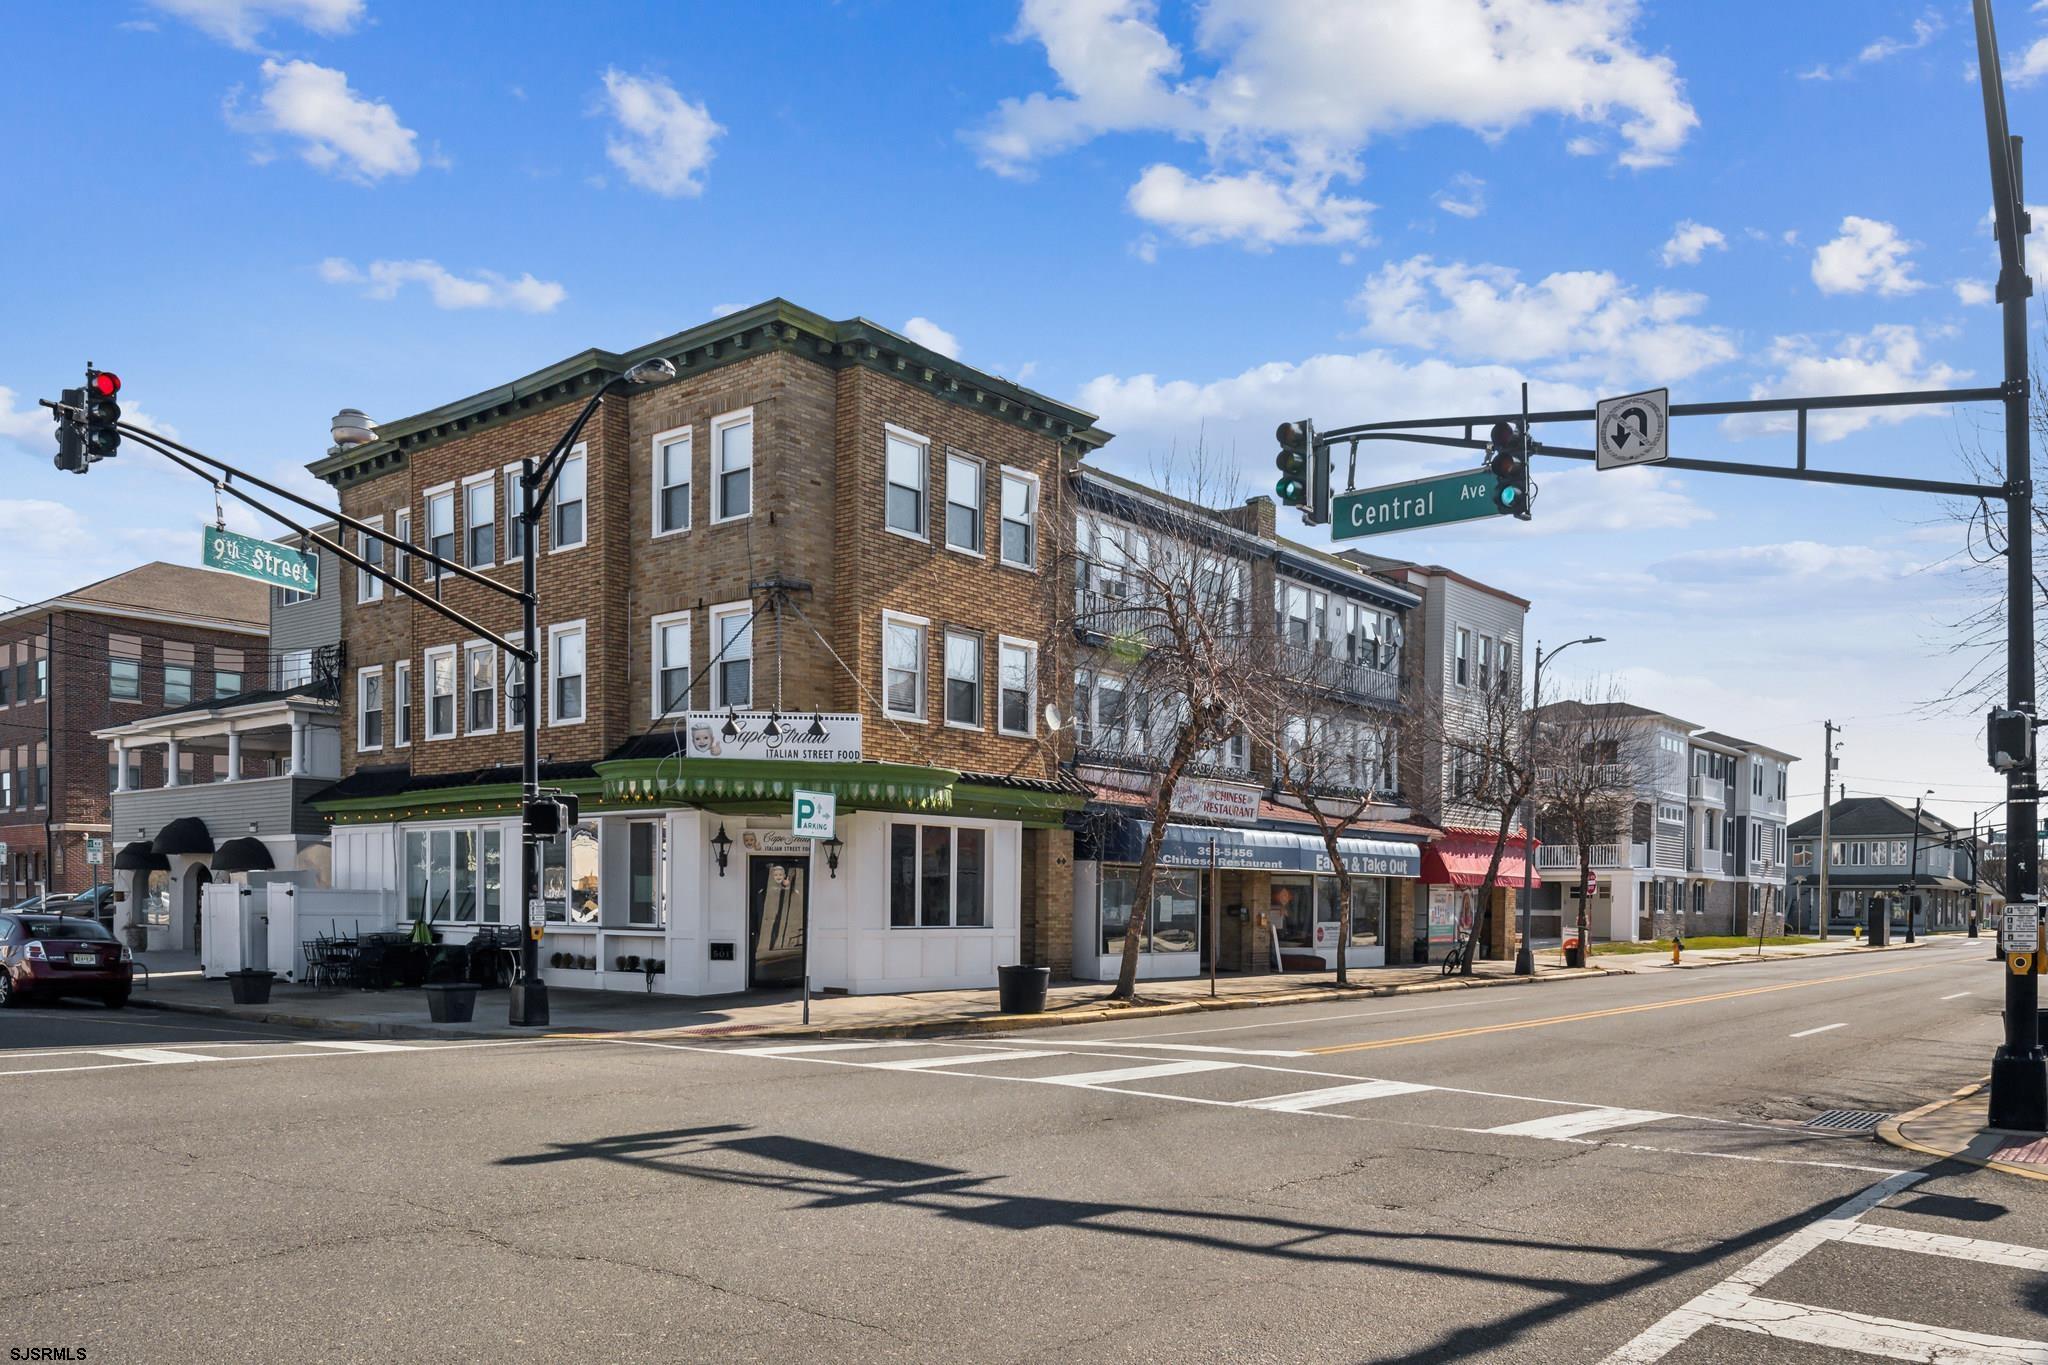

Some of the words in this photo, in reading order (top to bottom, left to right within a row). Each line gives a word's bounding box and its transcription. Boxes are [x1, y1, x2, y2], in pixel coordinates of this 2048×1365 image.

[1351, 491, 1433, 527] Central
[1460, 484, 1486, 501] Ave
[213, 538, 240, 560] 9th
[252, 548, 311, 583] Street
[766, 749, 799, 759] ITALIAN
[803, 750, 833, 760] STREET
[837, 750, 860, 760] FOOD
[1214, 790, 1247, 804] CHINESE
[1203, 801, 1255, 818] RESTAURANT
[1218, 857, 1283, 869] Restaurant
[1351, 856, 1360, 873] &
[1362, 856, 1387, 873] Take
[1389, 859, 1408, 875] Out
